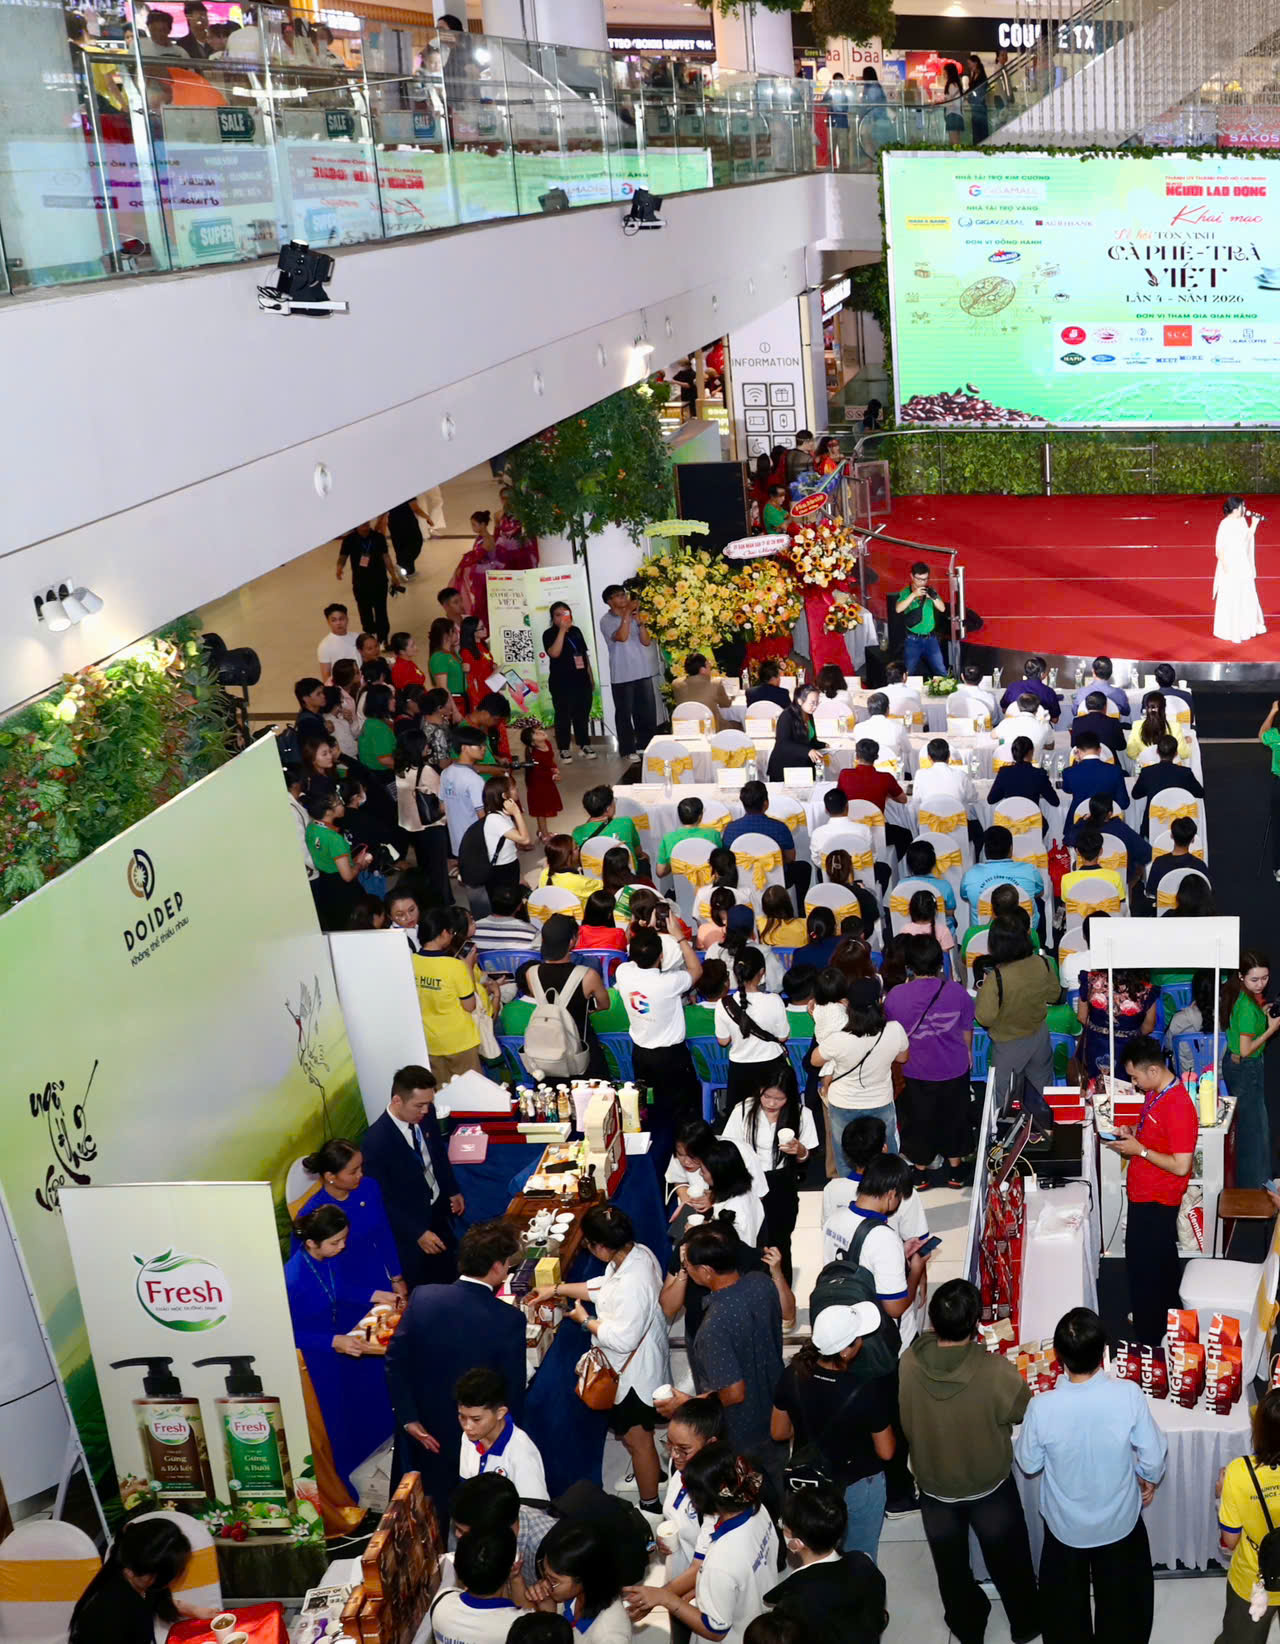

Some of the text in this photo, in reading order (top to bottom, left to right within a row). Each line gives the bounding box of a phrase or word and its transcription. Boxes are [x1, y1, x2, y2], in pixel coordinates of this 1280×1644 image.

[998, 23, 1069, 48] COUE
[220, 114, 245, 132] SALE
[328, 111, 348, 131] SALE
[414, 112, 430, 131] SALE
[1229, 134, 1280, 144] SAKOS
[1206, 186, 1230, 197] LAO
[200, 225, 233, 246] SUPER
[732, 356, 800, 368] INFORMATION
[123, 891, 183, 952] DOIDEP
[420, 976, 441, 987] HUIT
[145, 1280, 223, 1304] Fresh
[154, 1422, 187, 1434] Fresh
[234, 1421, 267, 1432] Fresh
[1250, 1489, 1278, 1500] FINNCE
